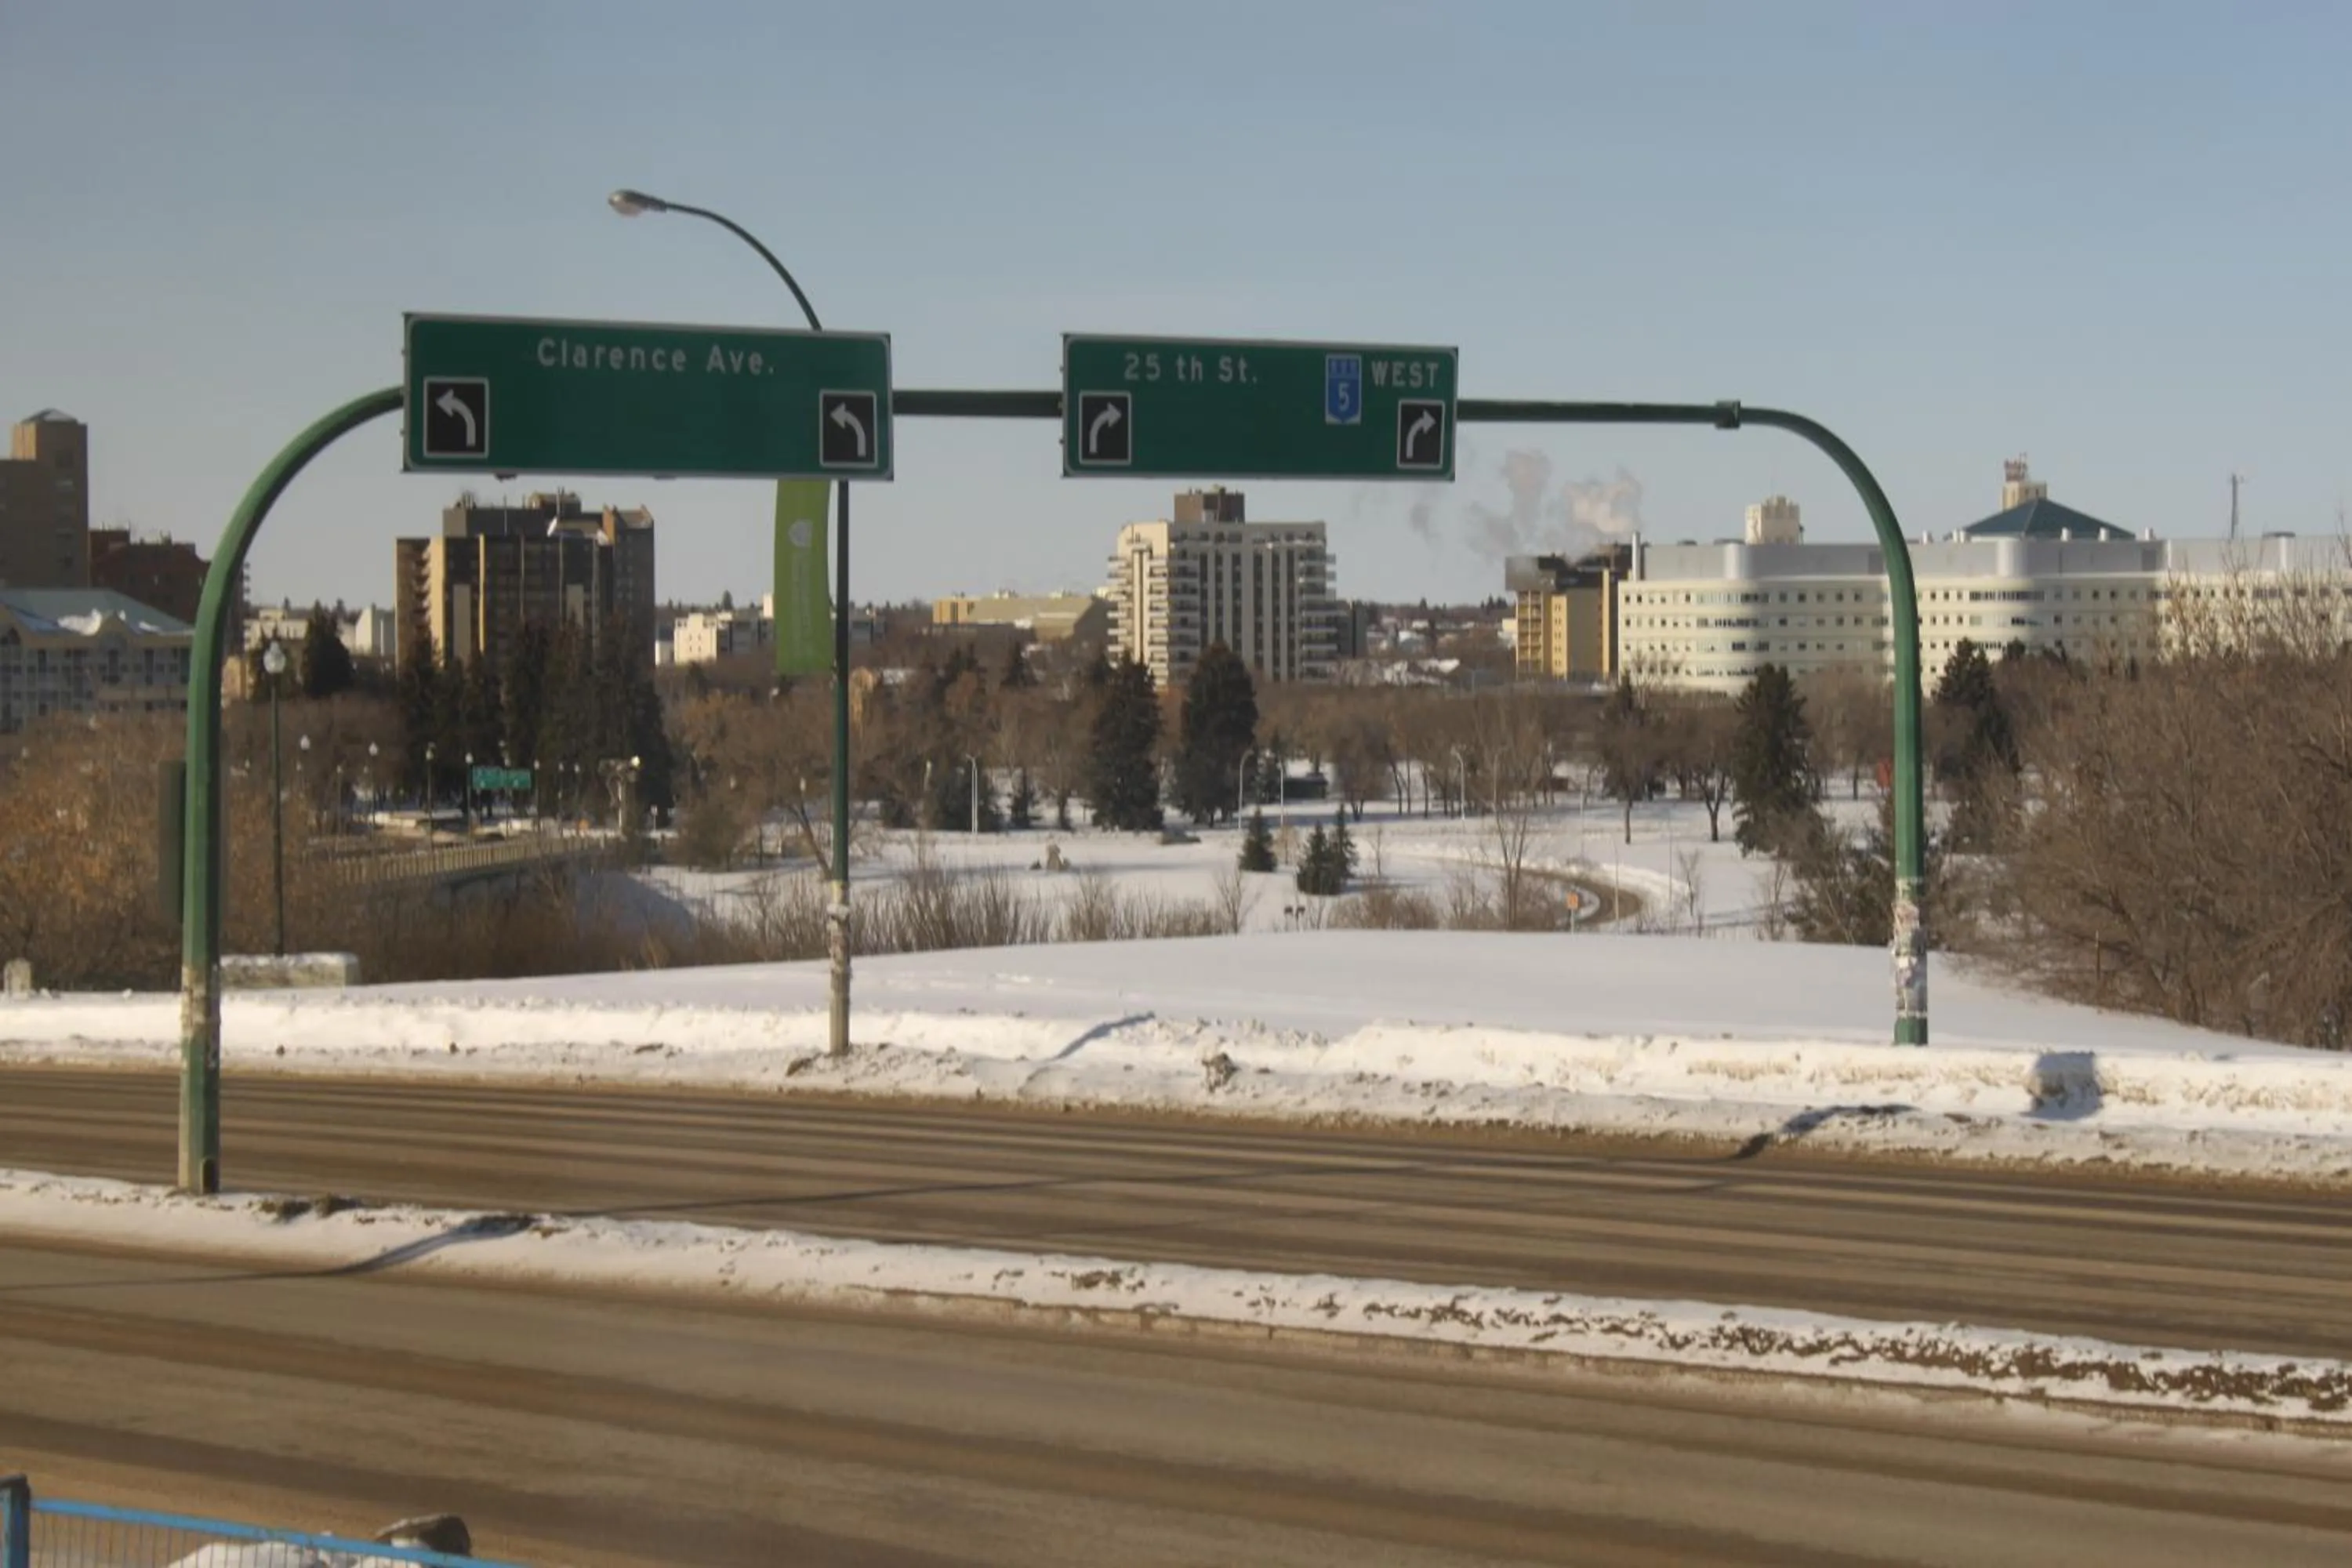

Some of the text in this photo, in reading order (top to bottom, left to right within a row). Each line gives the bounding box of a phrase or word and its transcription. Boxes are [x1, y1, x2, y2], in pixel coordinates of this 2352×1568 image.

[537, 337, 774, 376] Clarence Ave.
[1123, 352, 1258, 383] 25 th St.
[1371, 360, 1439, 389] WEST
[1338, 382, 1350, 412] 5
